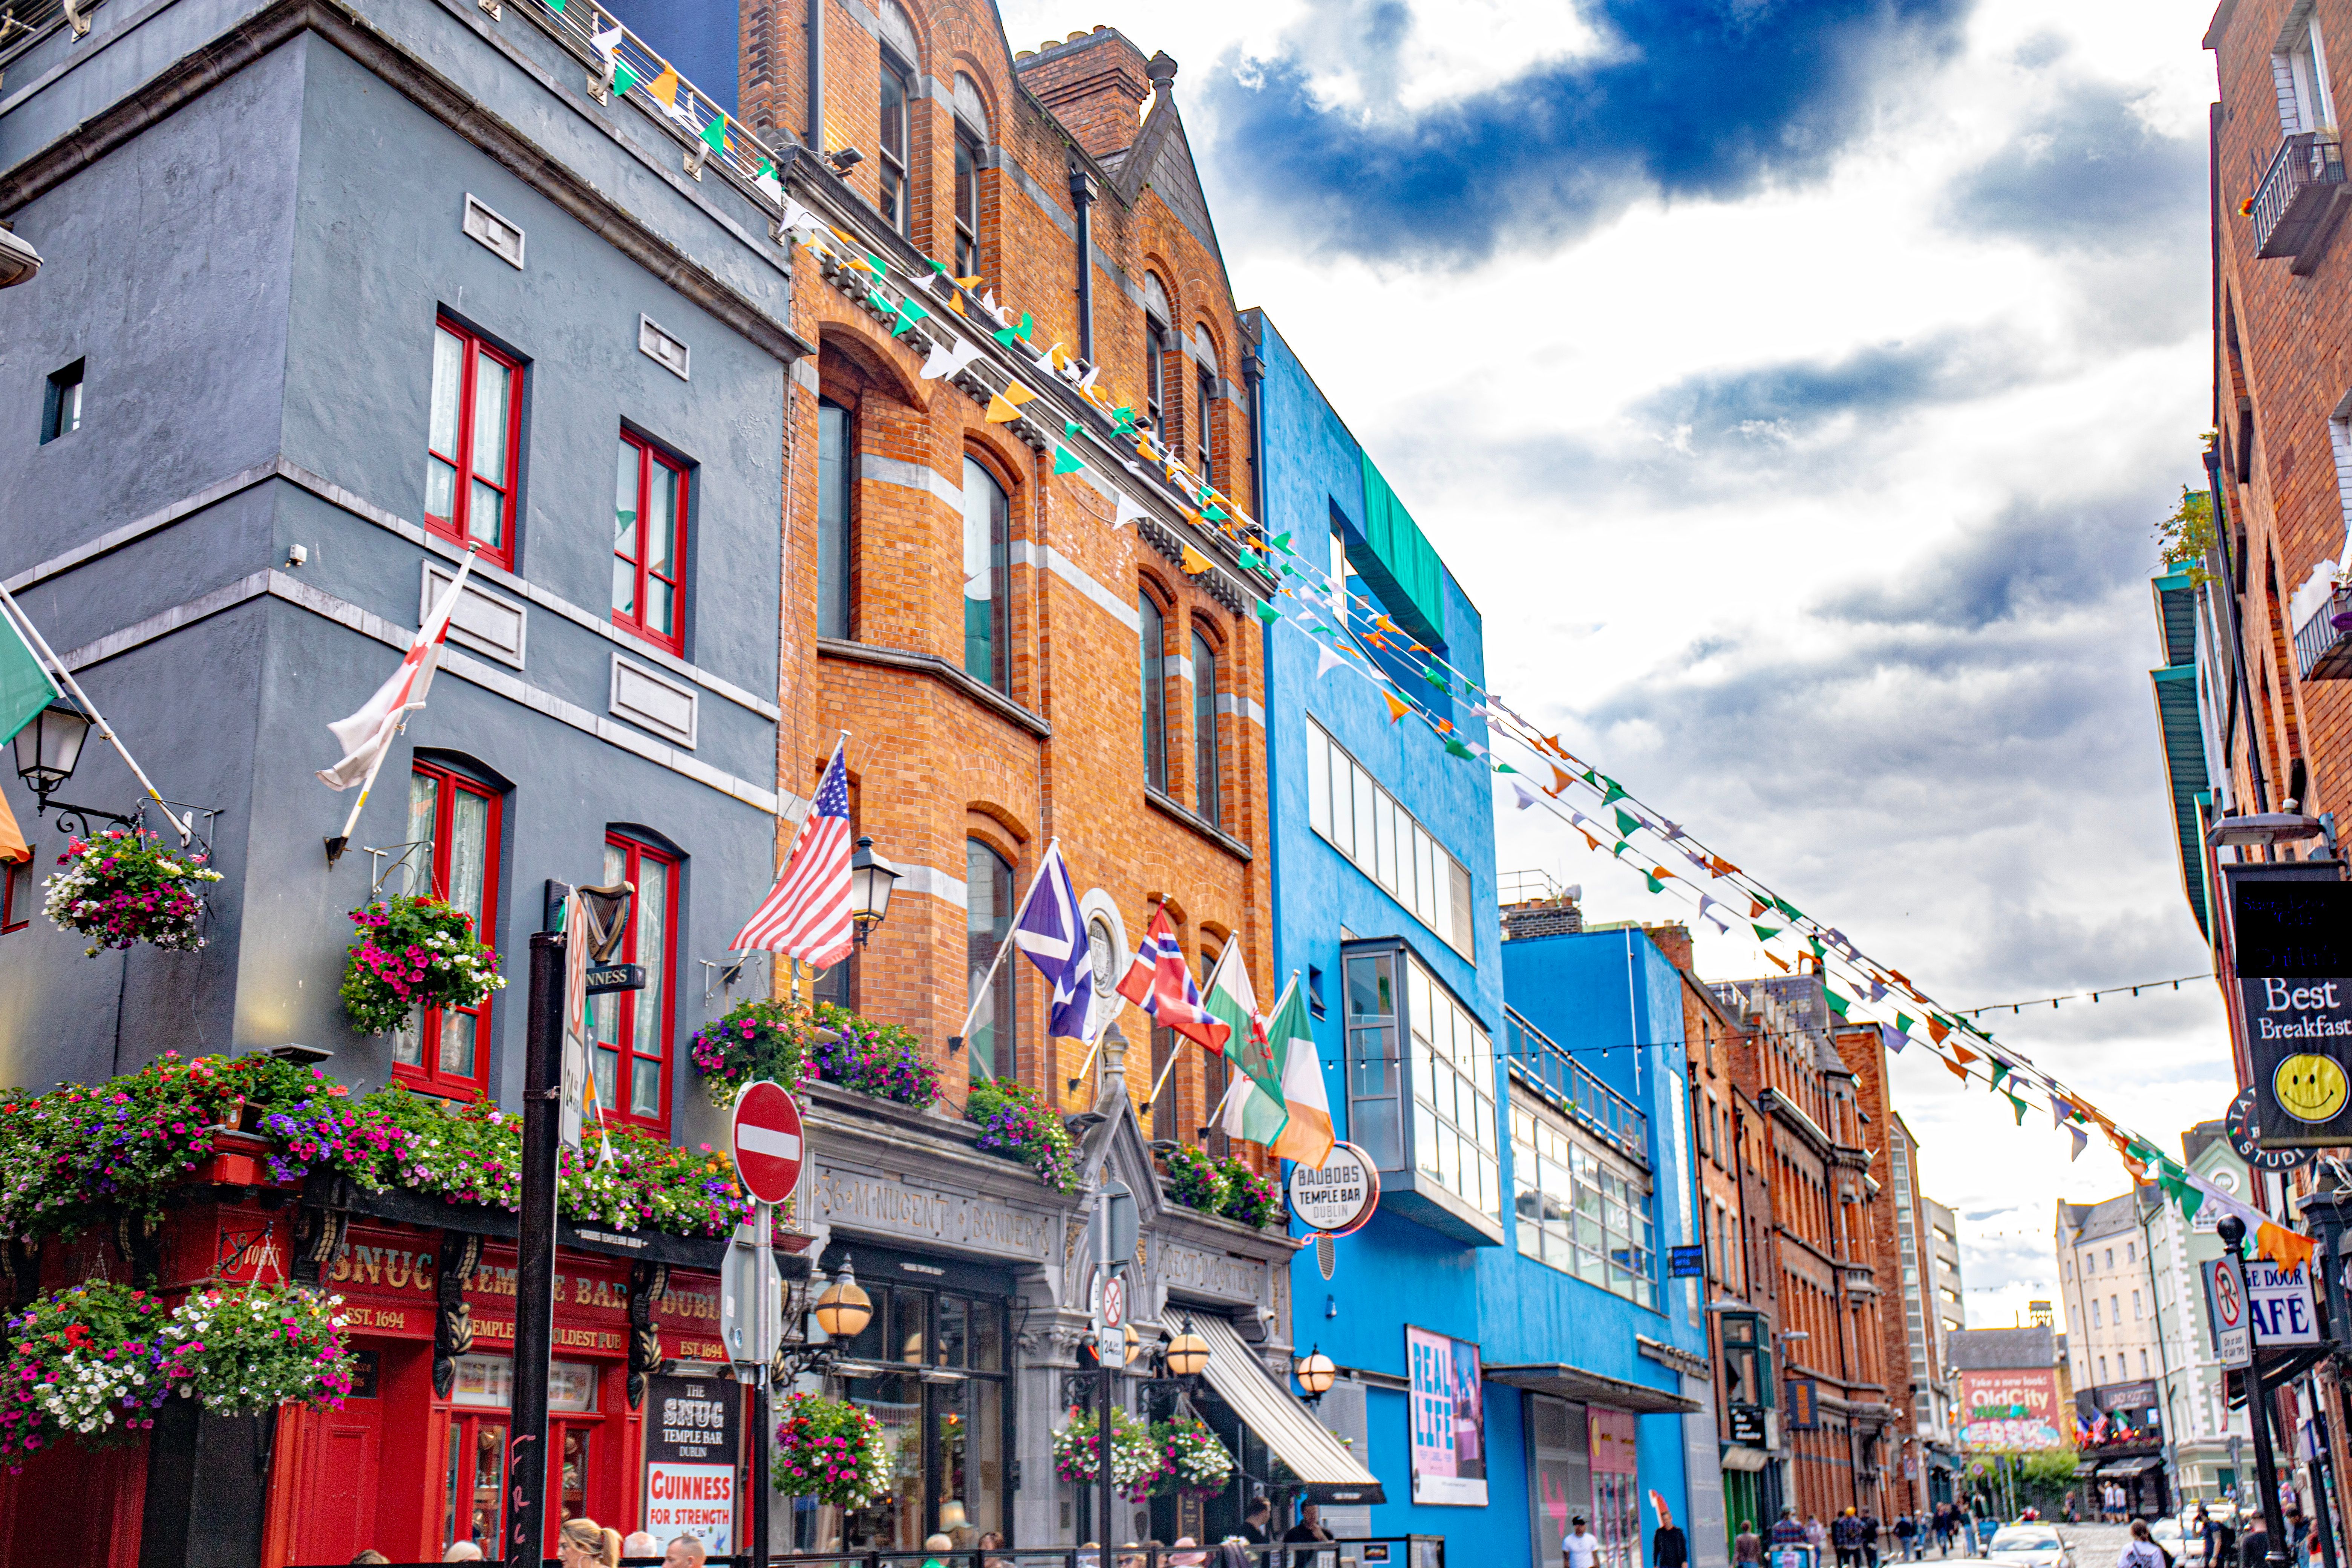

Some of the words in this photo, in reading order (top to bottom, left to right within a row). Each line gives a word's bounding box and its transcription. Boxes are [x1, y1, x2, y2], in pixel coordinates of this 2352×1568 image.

[2262, 978, 2341, 1012] Best
[2258, 1015, 2352, 1040] Breakfast
[566, 1068, 573, 1110] 24
[821, 1175, 844, 1211] 36
[854, 1181, 869, 1217] M
[876, 1186, 949, 1231] NUGENT
[1300, 1189, 1338, 1205] TEMPLE
[1341, 1188, 1360, 1202] BAR
[1313, 1205, 1348, 1218] DUBLIN
[330, 1243, 432, 1291] SNUG
[575, 1278, 628, 1309] BAR
[345, 1307, 372, 1328] EST.
[375, 1310, 404, 1329] 1694
[552, 1328, 597, 1347] OLDEST
[598, 1332, 621, 1349] PUB
[680, 1341, 700, 1355] EST.
[702, 1344, 722, 1358] 1694
[1413, 1342, 1450, 1397] REAL
[686, 1385, 705, 1397] THE
[1971, 1378, 1992, 1387] Take
[1972, 1388, 2049, 1410] OldCity
[663, 1398, 723, 1427] SNUG
[1415, 1396, 1454, 1450] LIFE
[663, 1429, 703, 1444] TEMPLE
[704, 1432, 723, 1444] BAR
[679, 1446, 707, 1457] DUBLIN
[651, 1470, 730, 1501] GUINNESS
[650, 1509, 671, 1525] FOR
[675, 1509, 729, 1525] STRENGTH
